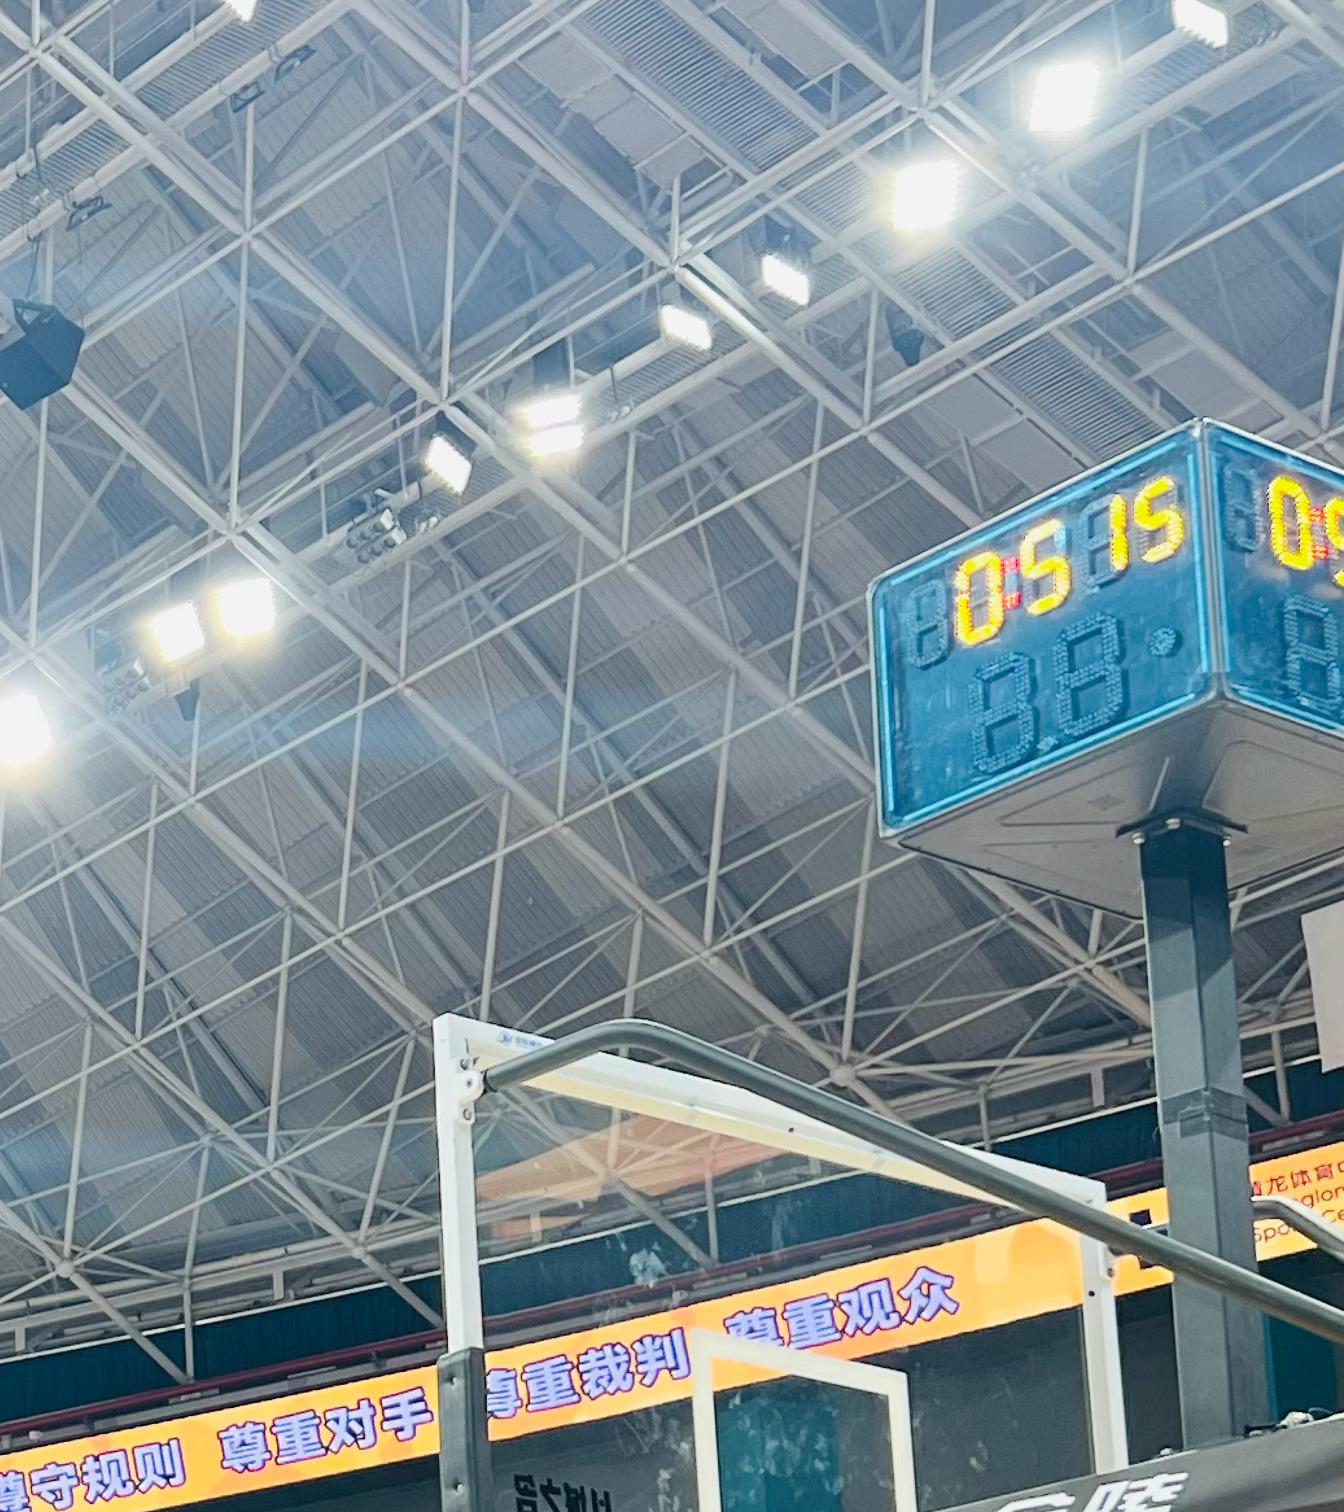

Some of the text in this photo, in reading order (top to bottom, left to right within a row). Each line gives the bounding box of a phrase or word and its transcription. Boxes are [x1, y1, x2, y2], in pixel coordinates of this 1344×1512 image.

[218, 1387, 435, 1475] 尊重对手
[486, 1327, 692, 1418] 尊重裁判
[724, 1265, 960, 1351] 尊重观众
